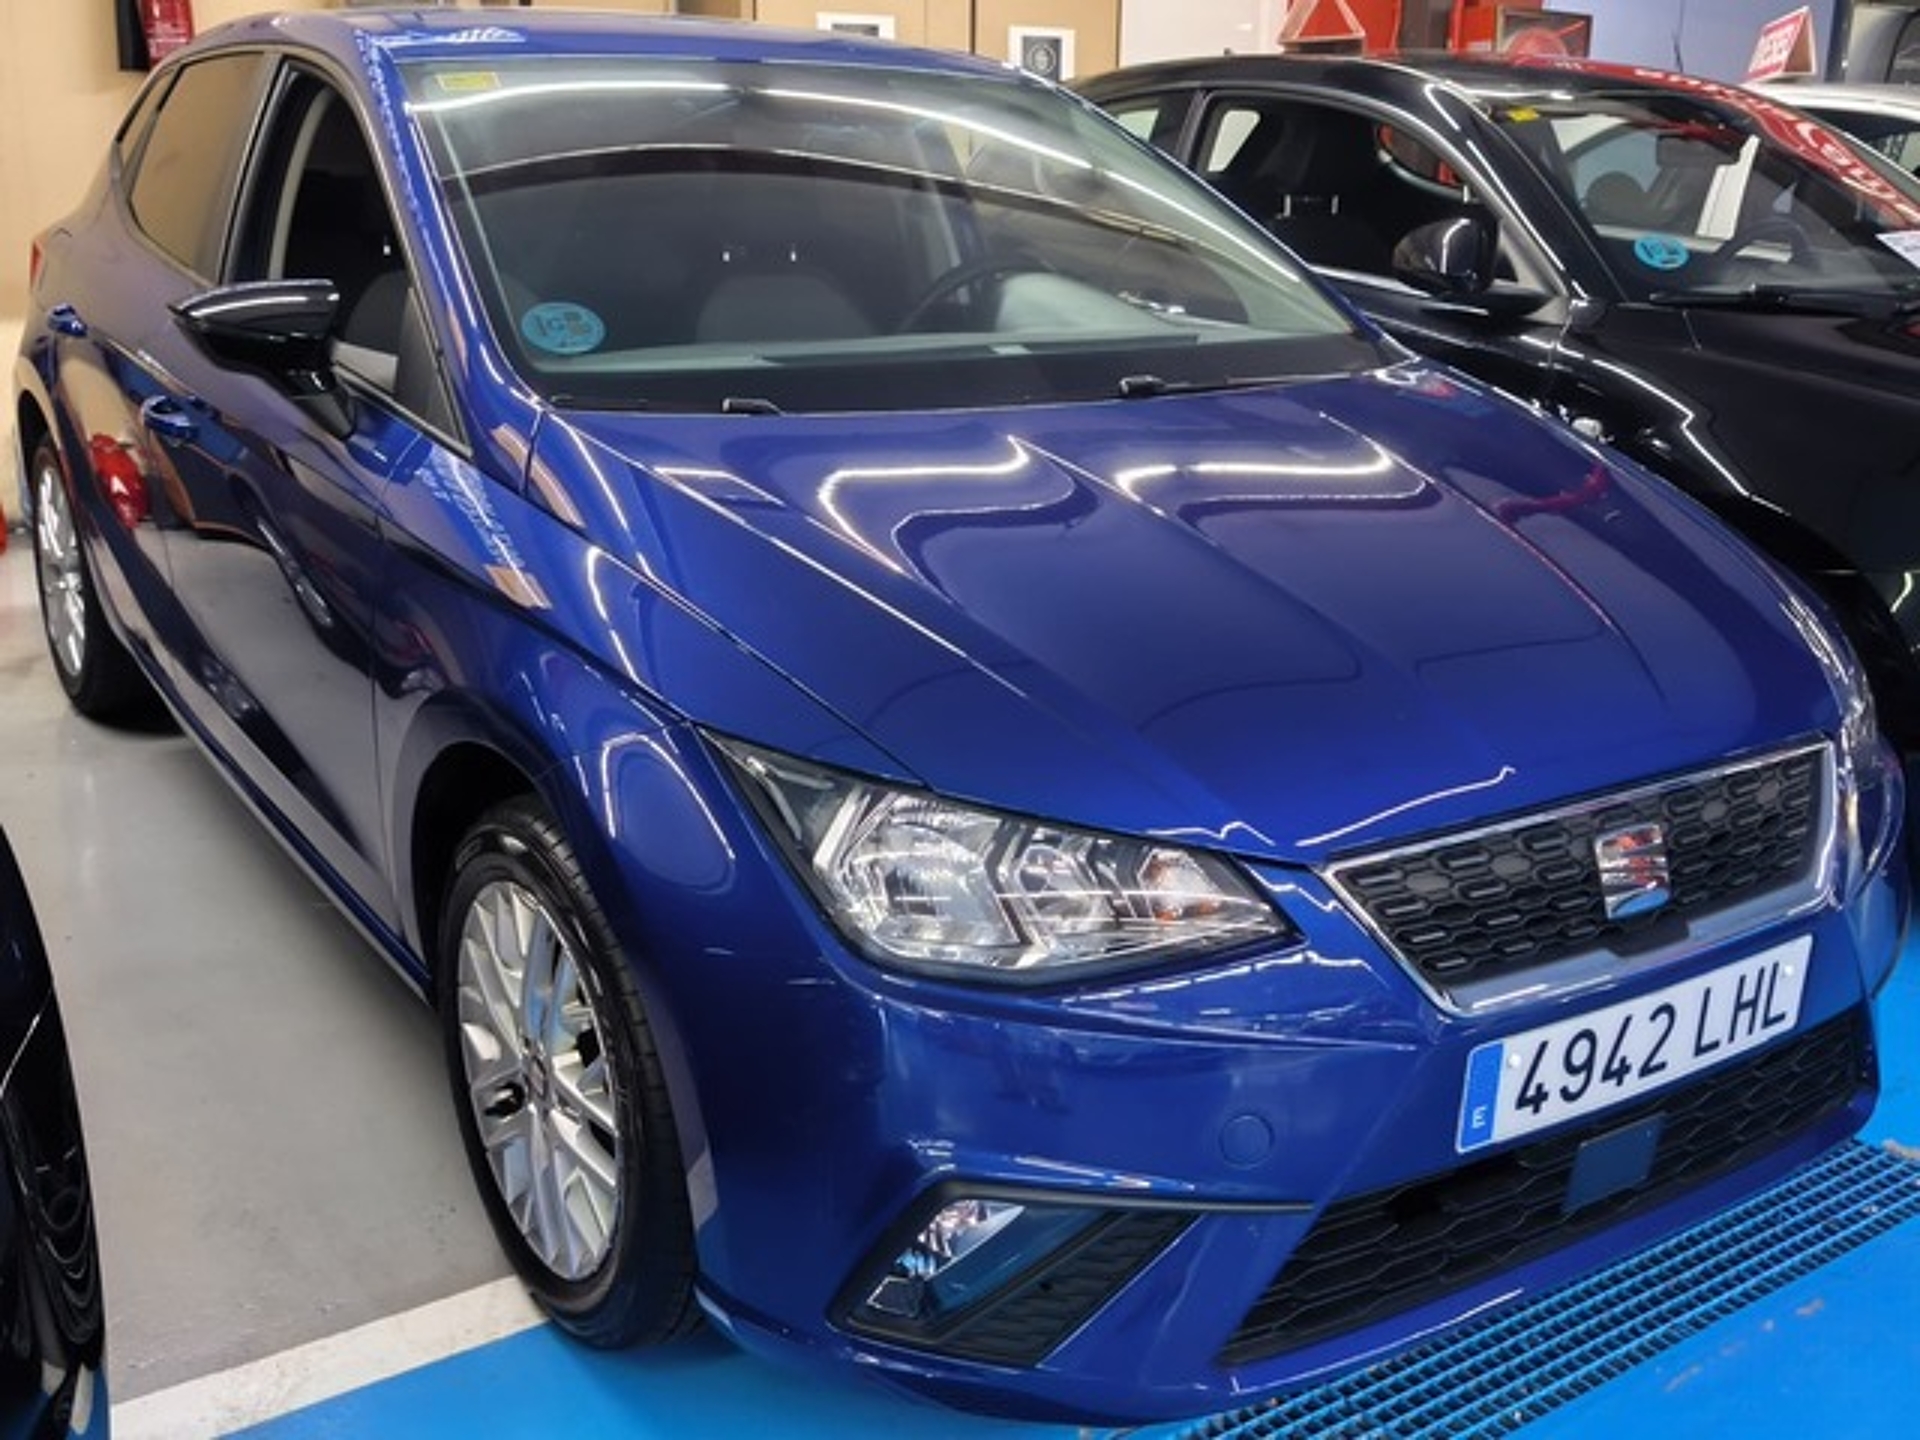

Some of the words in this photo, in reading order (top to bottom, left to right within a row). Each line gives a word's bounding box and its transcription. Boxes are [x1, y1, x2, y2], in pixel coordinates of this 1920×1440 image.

[1472, 1106, 1487, 1129] E
[1515, 1003, 1676, 1114] 4942
[1694, 961, 1787, 1058] LHL
